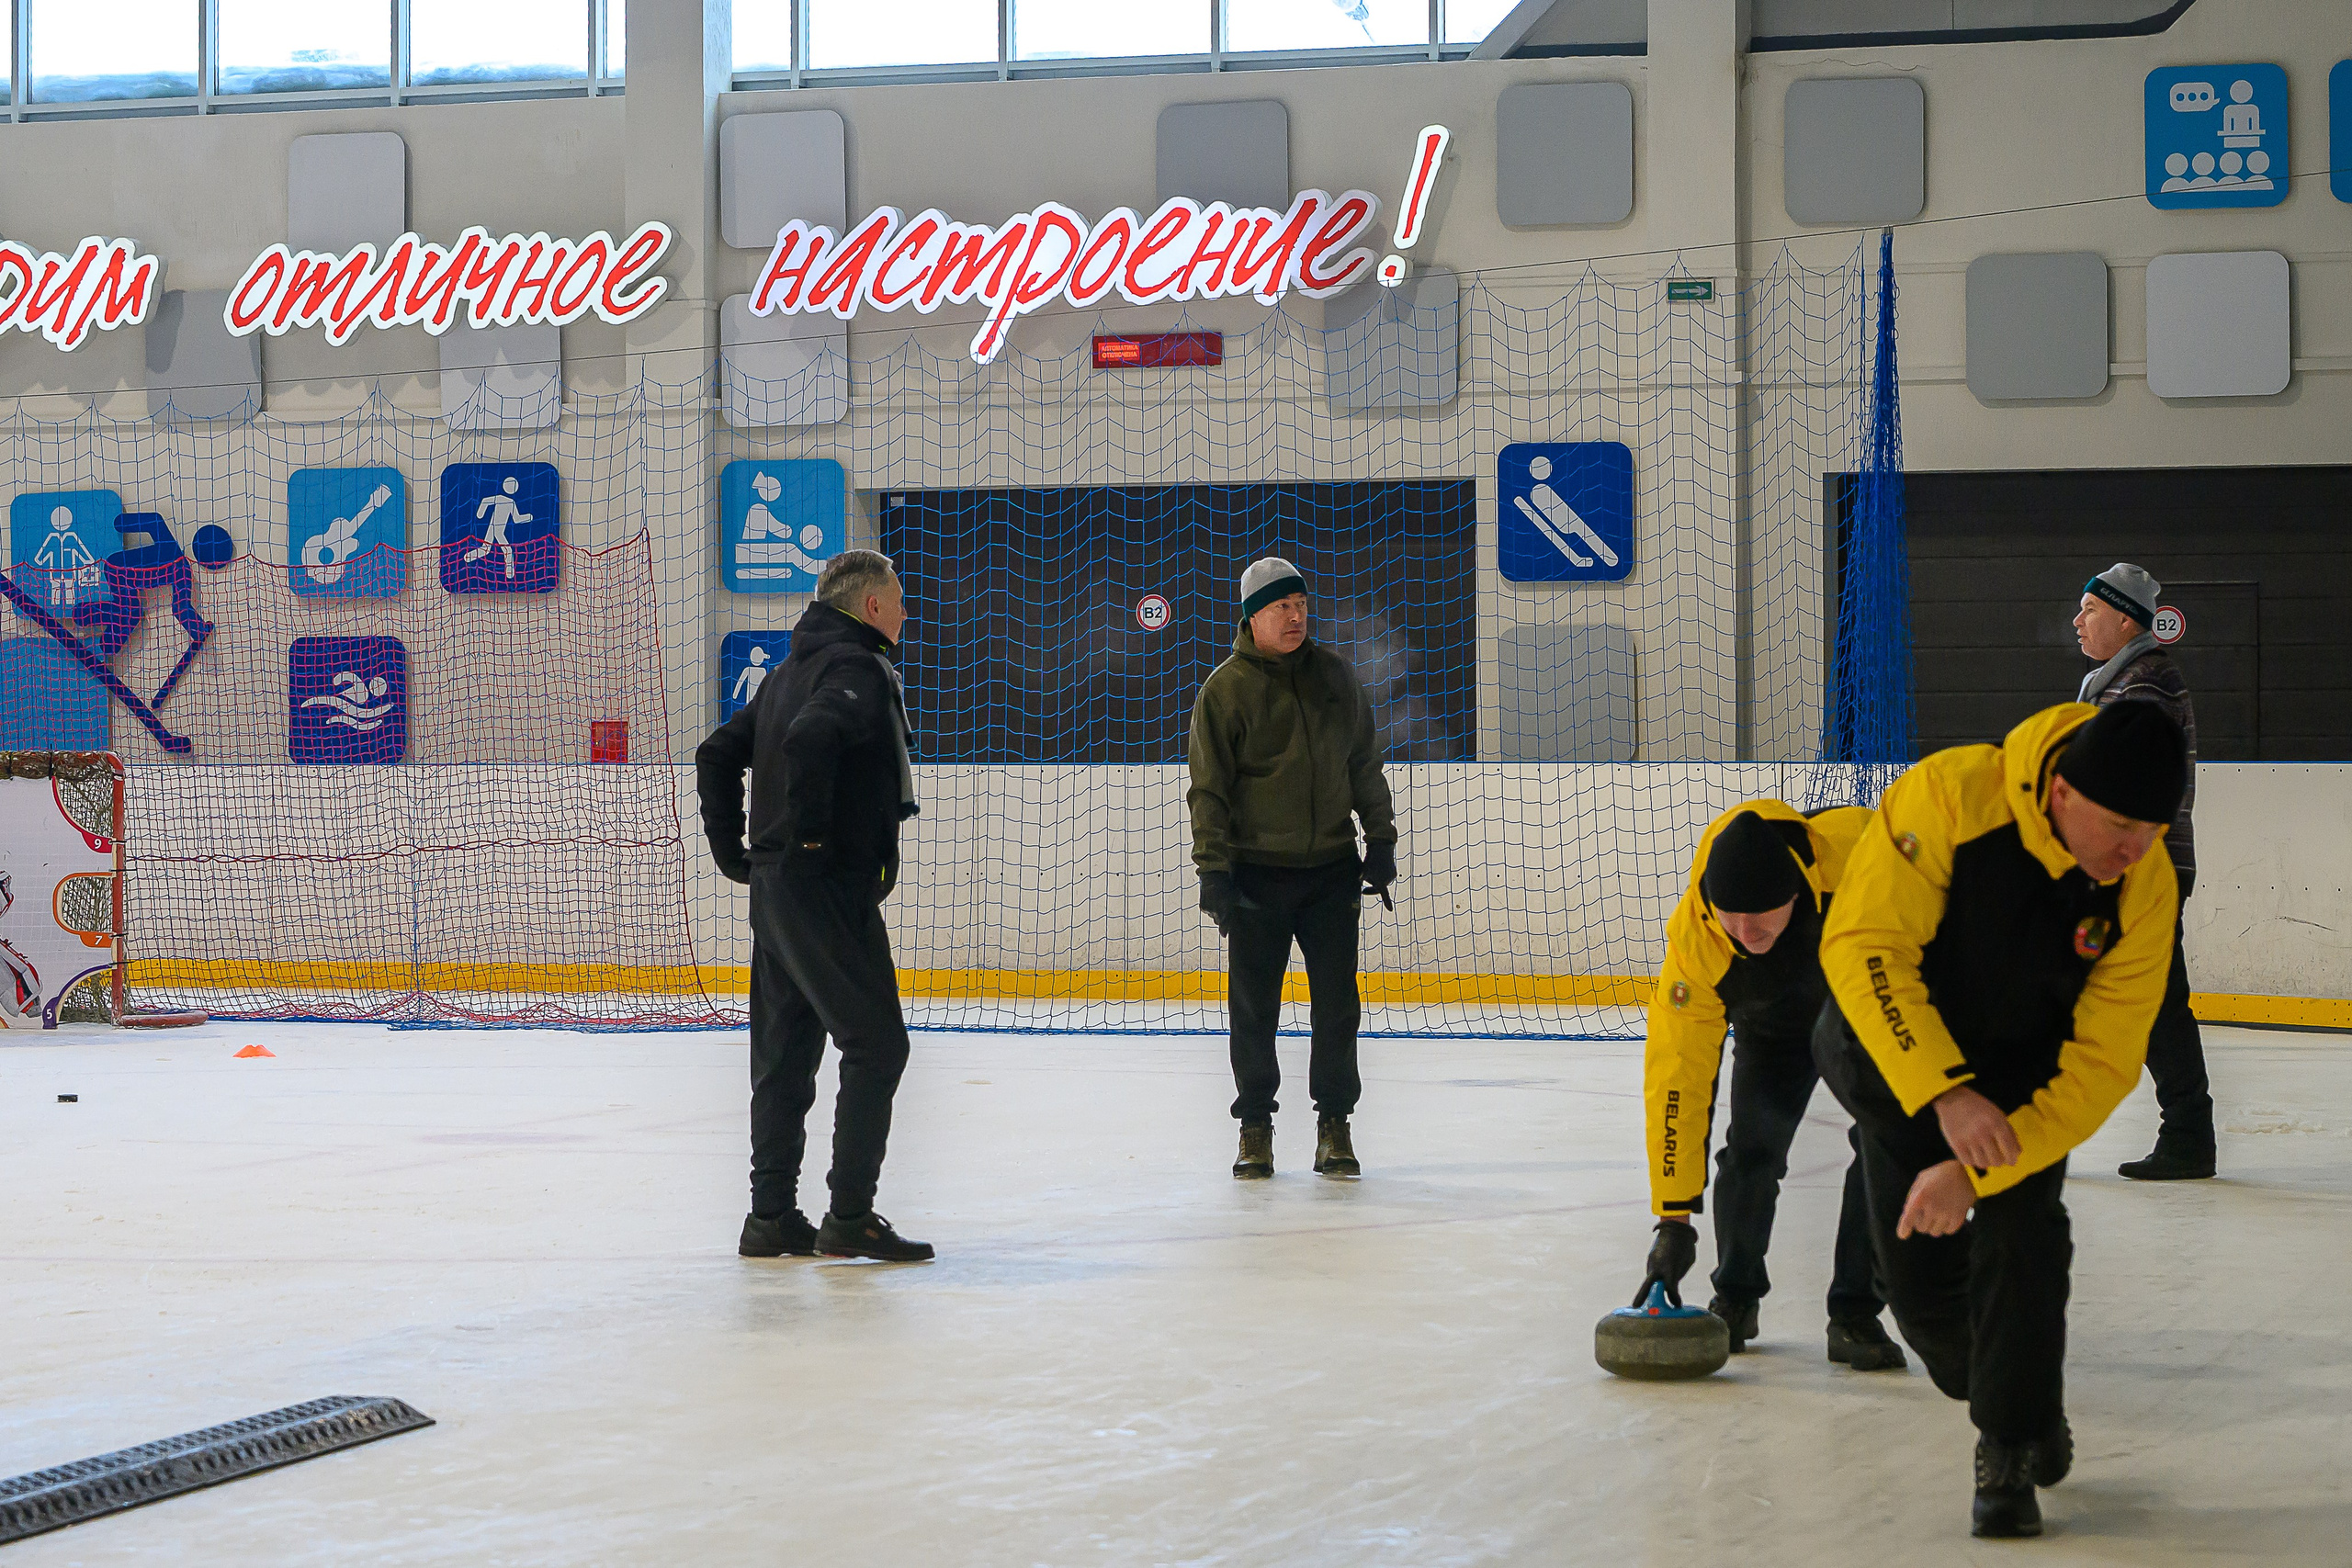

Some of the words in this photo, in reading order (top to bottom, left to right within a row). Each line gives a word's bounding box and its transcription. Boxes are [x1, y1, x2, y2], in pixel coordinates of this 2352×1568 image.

[232, 230, 662, 337] отличное
[756, 134, 1441, 361] настроение!
[94, 838, 102, 850] 9
[95, 935, 103, 945] 7
[46, 1008, 53, 1020] 5
[1867, 956, 1917, 1052] BELARUS
[1663, 1089, 1680, 1178] BELARUS
